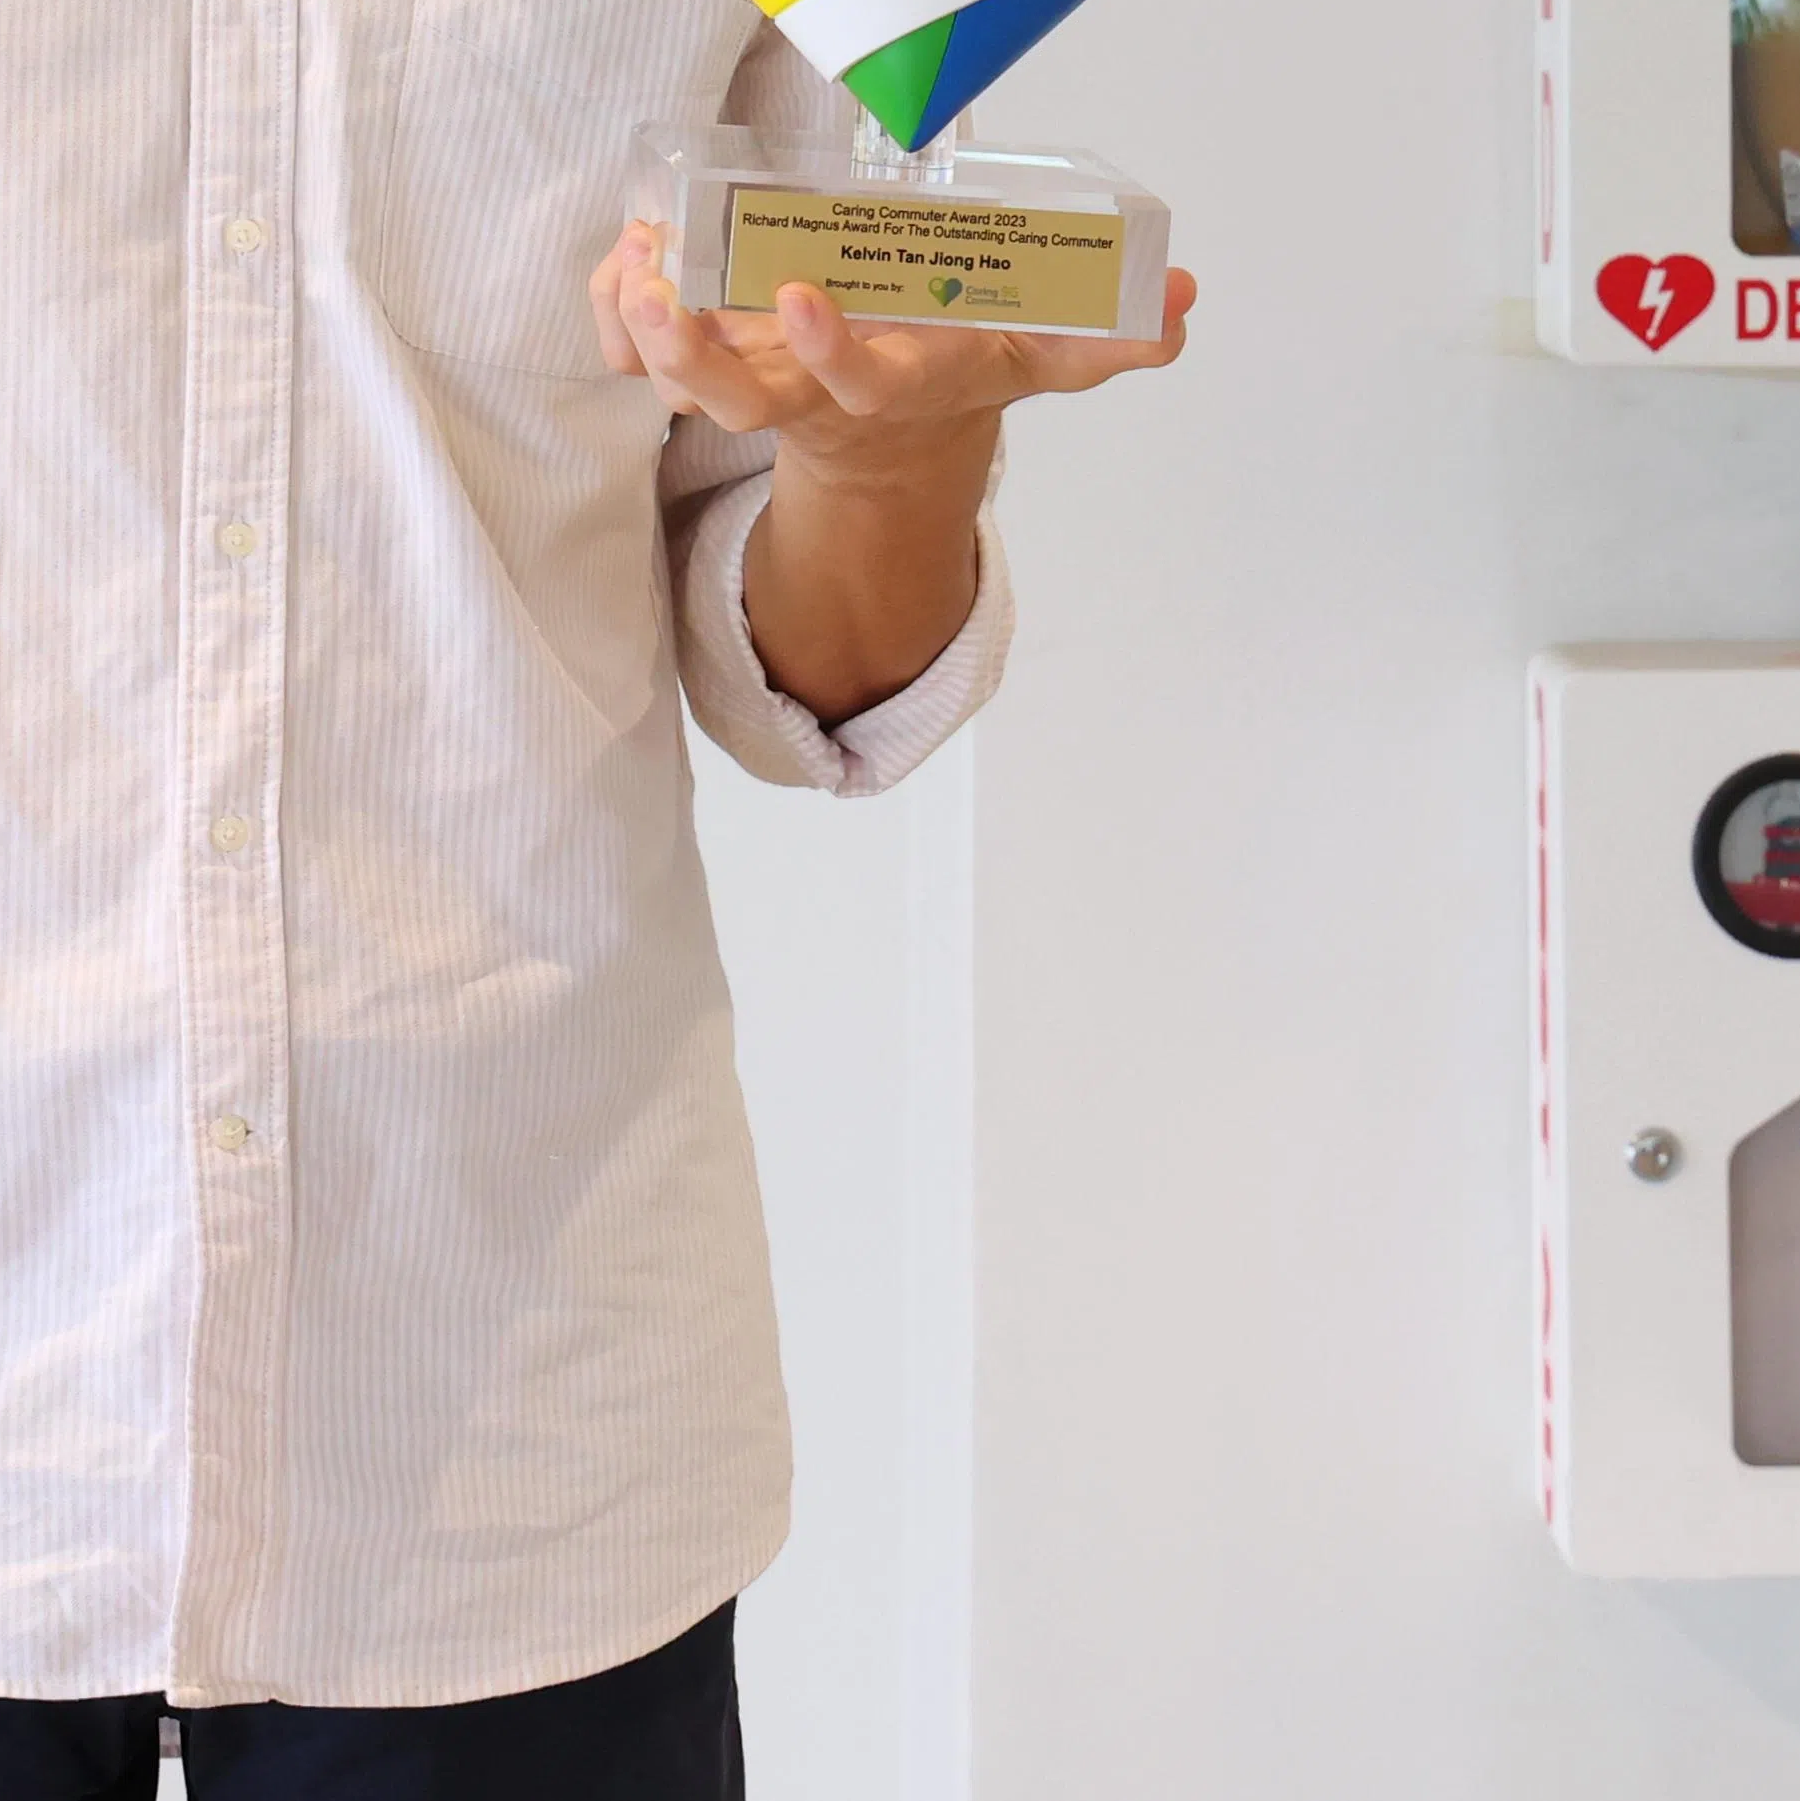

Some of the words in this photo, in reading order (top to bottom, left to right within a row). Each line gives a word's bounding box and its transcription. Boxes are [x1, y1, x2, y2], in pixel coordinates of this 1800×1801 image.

[832, 203, 875, 219] Caring
[879, 207, 946, 222] Commuter
[949, 211, 990, 225] Award
[994, 214, 1026, 227] 2023
[743, 213, 788, 228] Richard
[792, 217, 839, 233] Magnus
[842, 221, 880, 234] Award
[883, 223, 903, 236] For
[907, 224, 930, 237] The
[934, 226, 1005, 244] Outstanding
[1009, 231, 1048, 247] Caring
[1051, 234, 1113, 249] Commuter
[841, 245, 891, 261] Kelvin
[896, 249, 925, 264] Tan
[929, 252, 974, 271] Jiong
[979, 255, 1011, 270] Hao
[826, 278, 861, 291] Brought
[873, 284, 889, 292] you
[890, 283, 905, 293] by:
